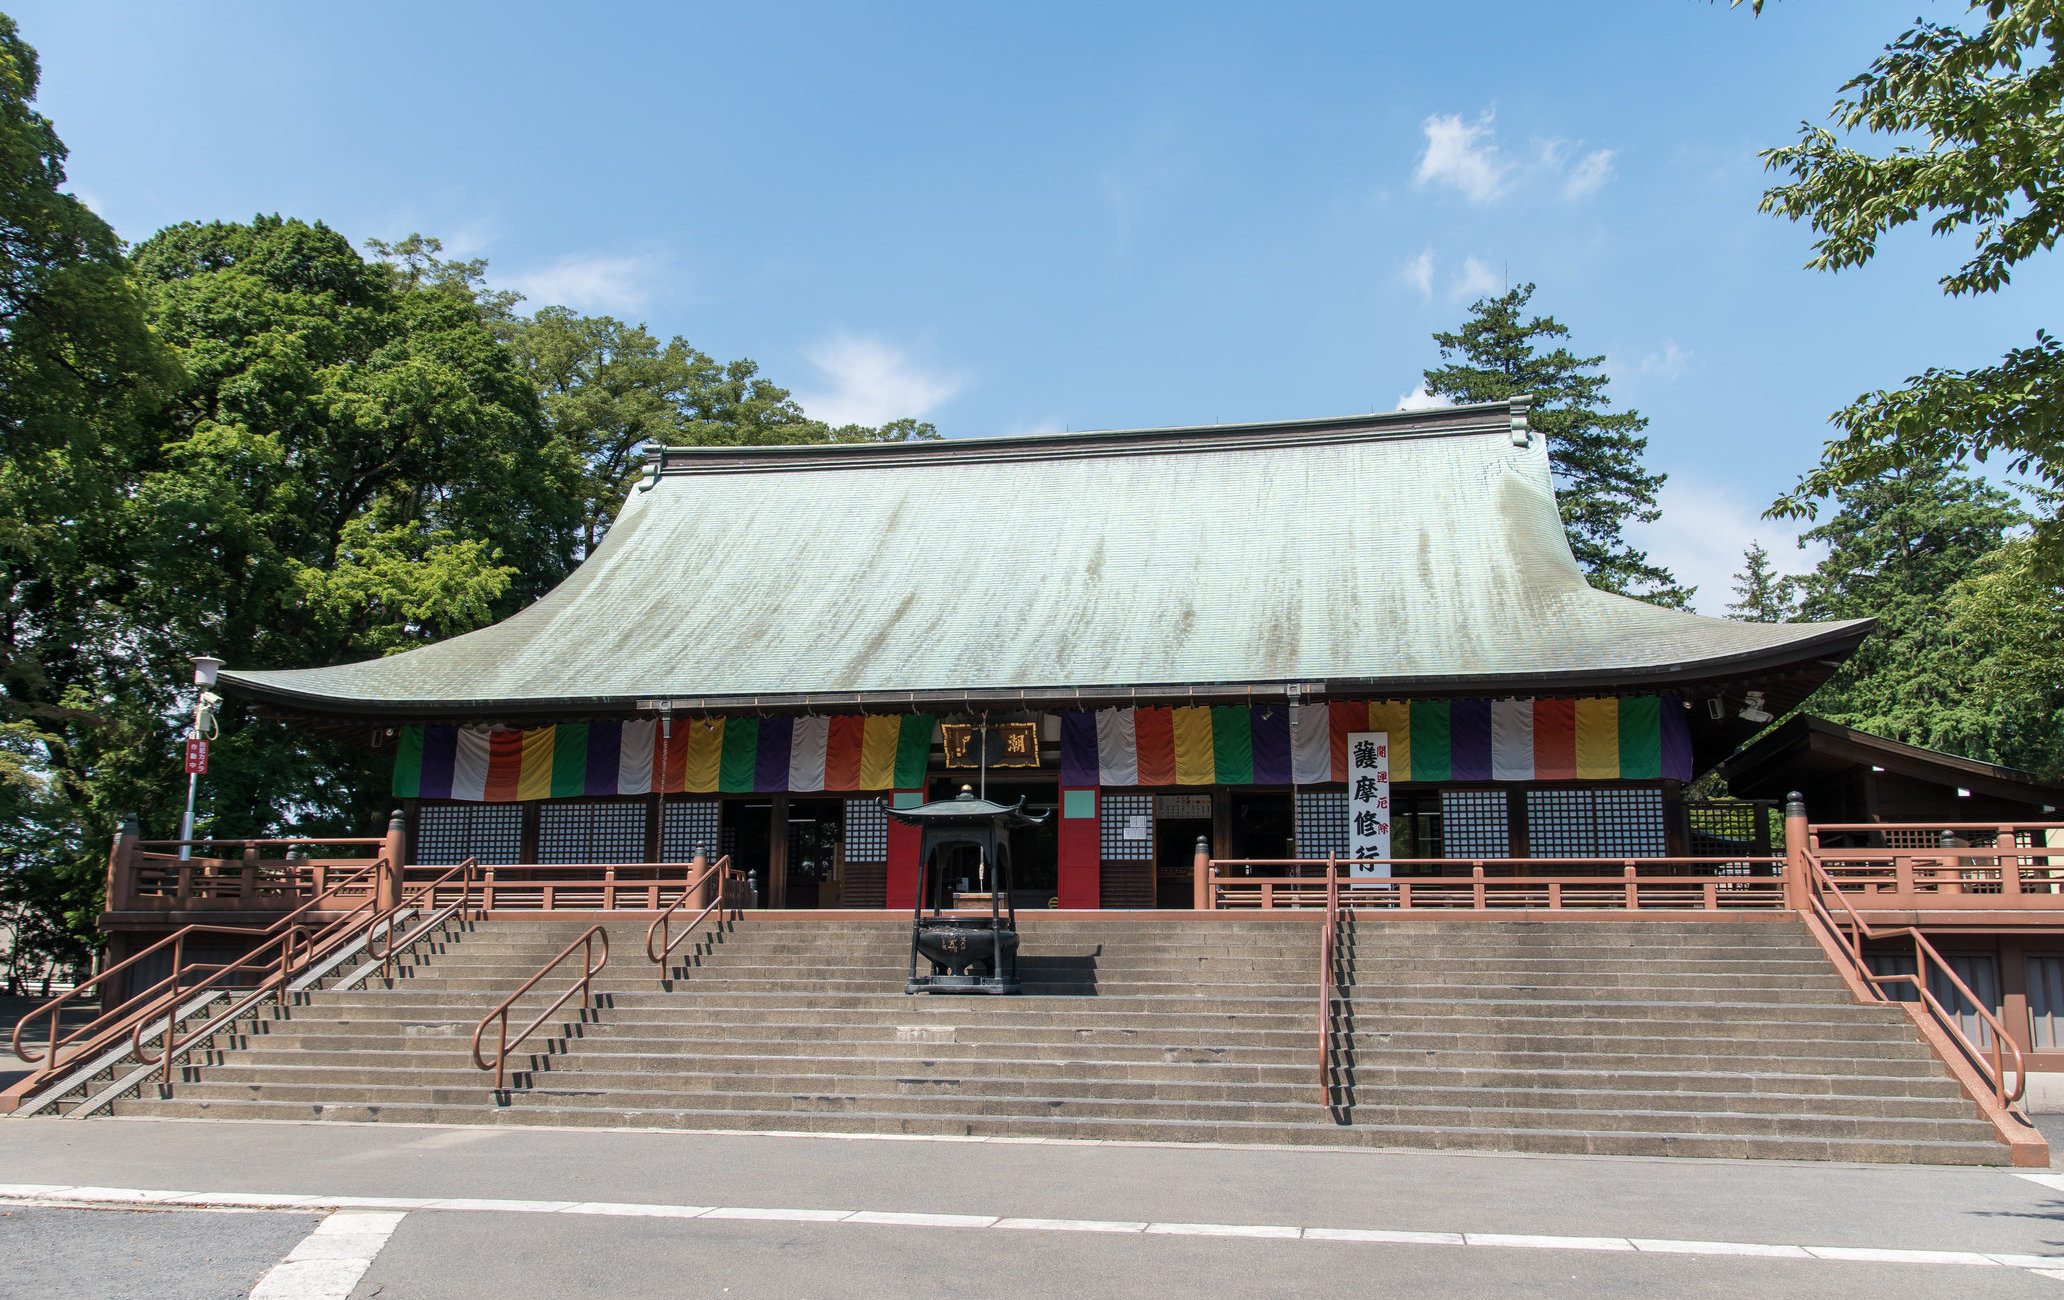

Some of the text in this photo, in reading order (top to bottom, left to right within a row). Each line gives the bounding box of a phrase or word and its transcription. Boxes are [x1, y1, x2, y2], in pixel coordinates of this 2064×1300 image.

[1353, 740, 1380, 872] 護摩修行
[1376, 745, 1389, 835] 開運厄除
